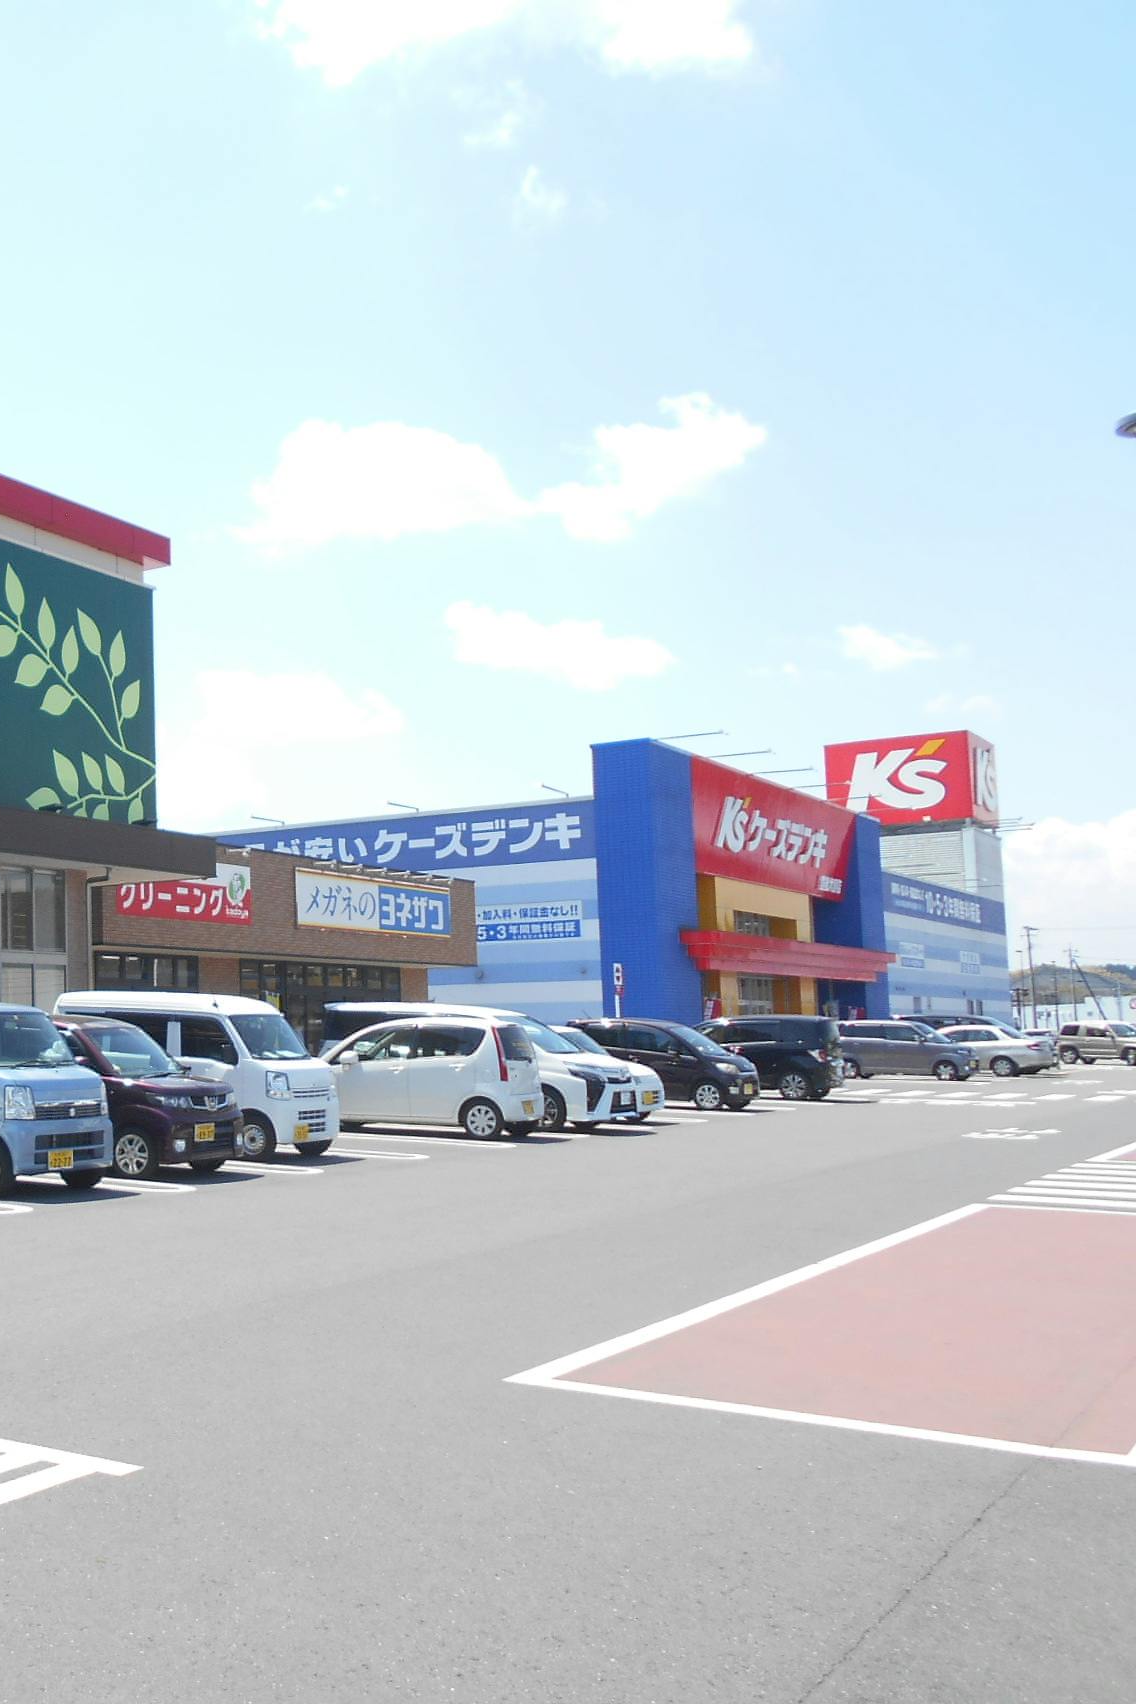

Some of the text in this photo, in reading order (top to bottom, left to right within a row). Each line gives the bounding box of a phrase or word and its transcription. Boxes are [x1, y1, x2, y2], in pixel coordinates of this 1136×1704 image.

[120, 882, 224, 917] クリーニング
